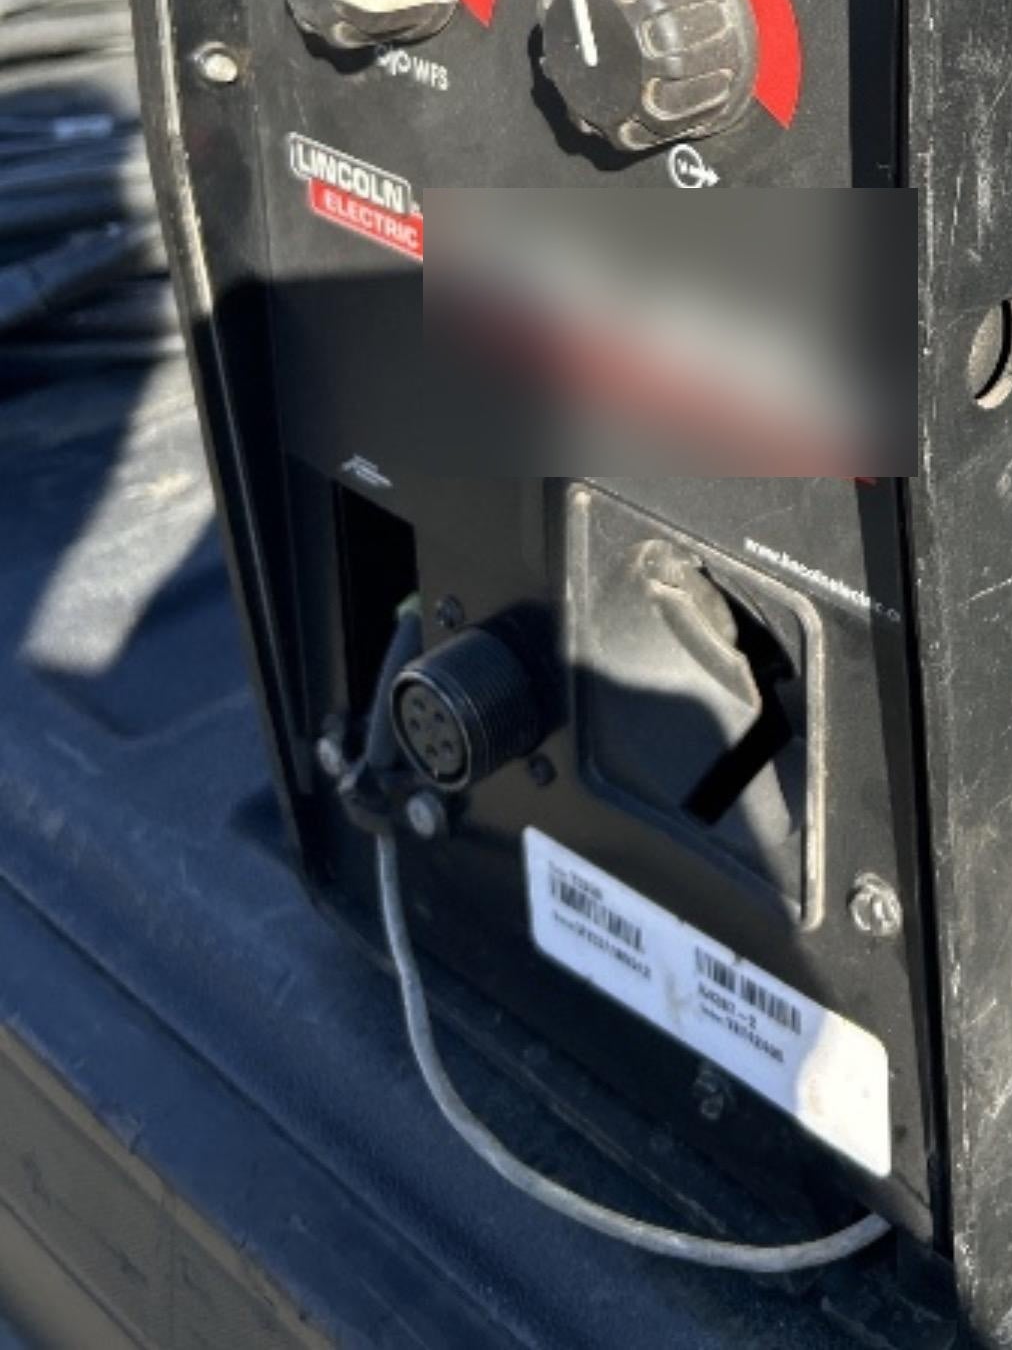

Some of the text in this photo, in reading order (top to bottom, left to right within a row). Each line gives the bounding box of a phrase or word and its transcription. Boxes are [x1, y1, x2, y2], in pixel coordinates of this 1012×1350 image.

[413, 56, 449, 91] WFS
[298, 142, 406, 215] LINCOLN
[323, 189, 419, 249] ELECTRIC
